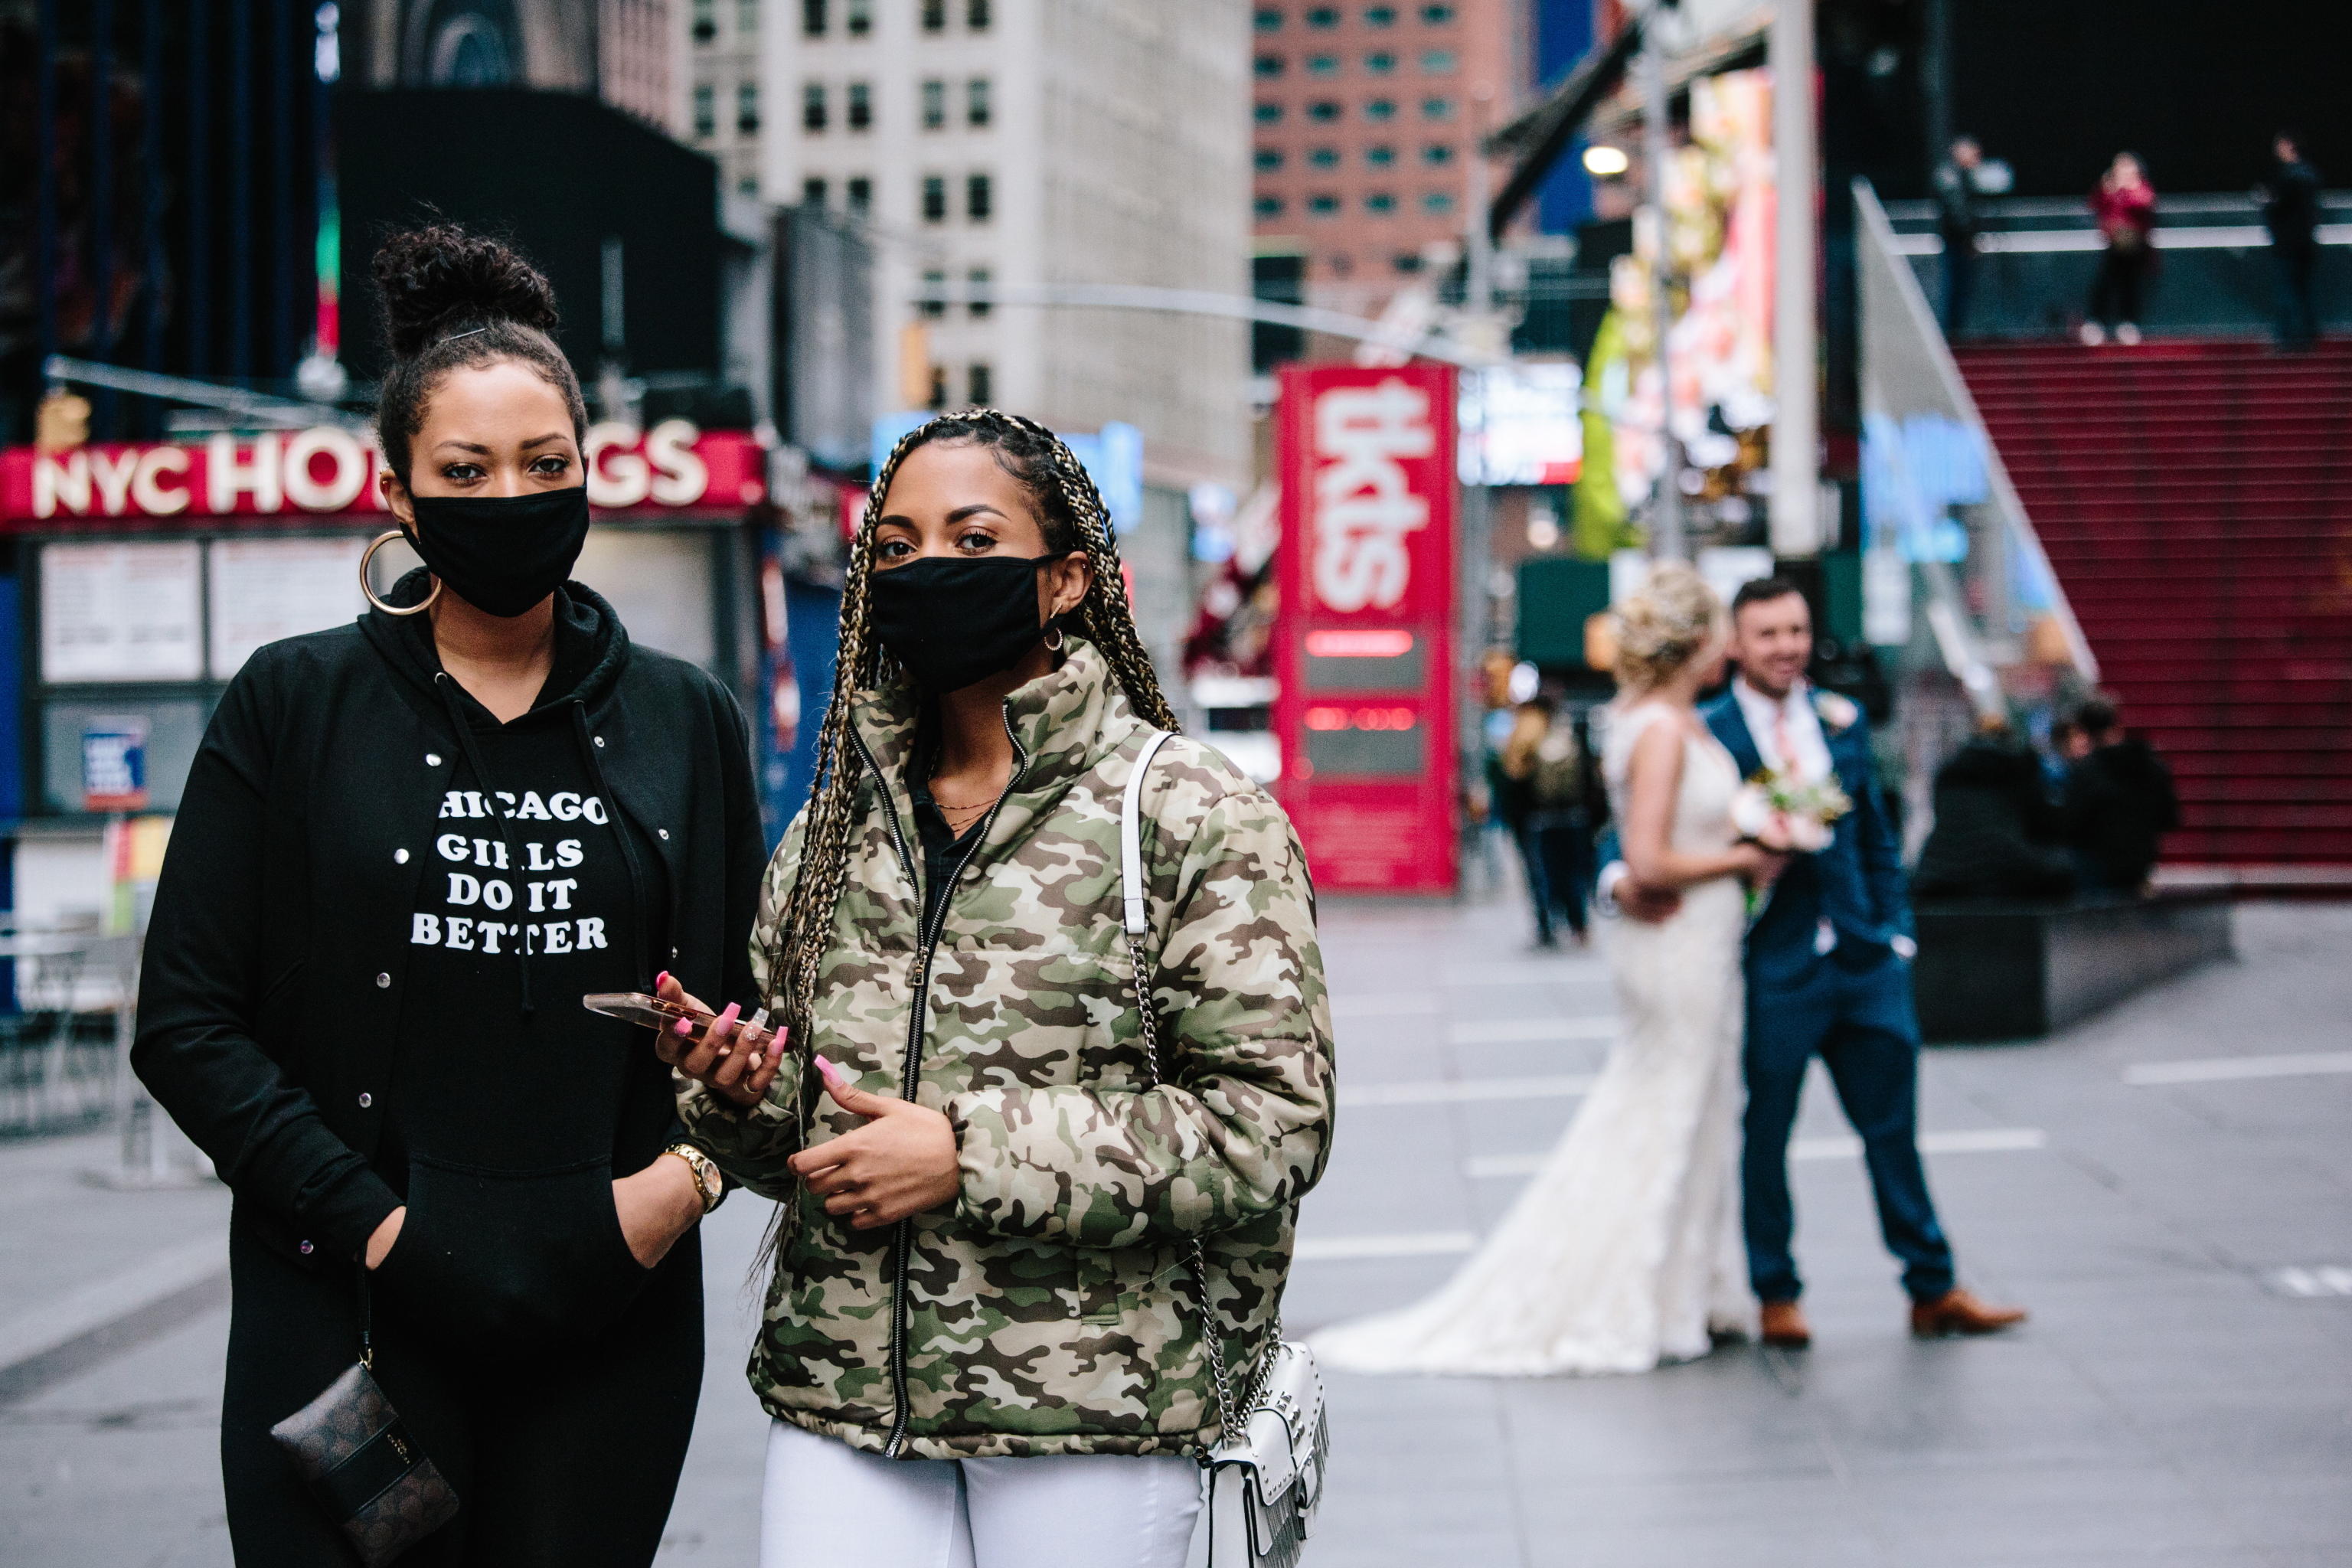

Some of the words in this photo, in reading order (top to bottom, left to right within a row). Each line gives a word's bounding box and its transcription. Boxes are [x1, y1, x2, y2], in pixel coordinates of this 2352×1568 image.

[32, 446, 191, 518] NYC
[1314, 377, 1436, 612] tkts
[439, 790, 609, 825] HICAGO
[446, 873, 513, 910] DO
[528, 878, 577, 912] IT
[410, 913, 608, 956] BETTER
